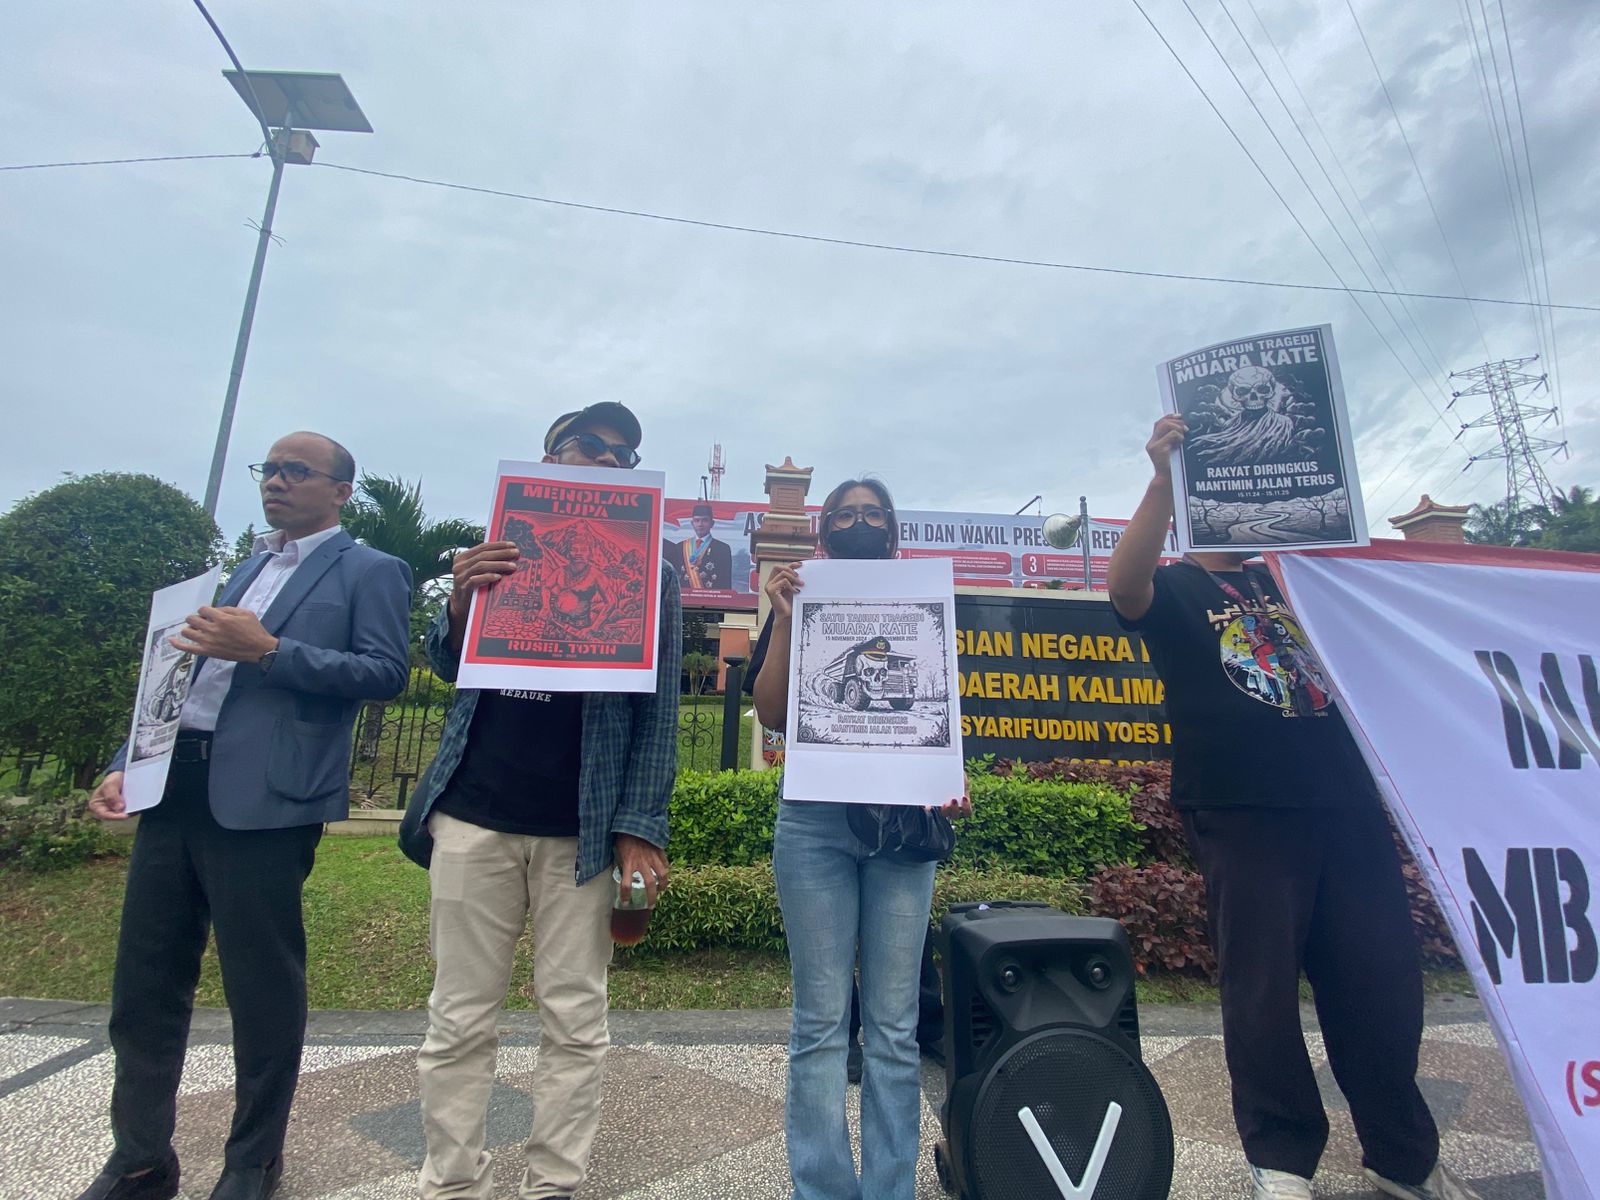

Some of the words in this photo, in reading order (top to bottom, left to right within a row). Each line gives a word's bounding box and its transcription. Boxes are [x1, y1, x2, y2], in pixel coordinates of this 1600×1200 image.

[1174, 354, 1206, 370] SATU
[1210, 342, 1254, 358] TAHUN
[1257, 334, 1315, 350] TRAGEDI
[1175, 355, 1252, 384] MUARA
[1260, 346, 1318, 367] KATE
[1206, 465, 1250, 478] RAKYAT
[1253, 461, 1318, 476] DIRINGKUS
[1195, 479, 1253, 492] MANTIMIN
[1256, 477, 1292, 489] JALAN
[1295, 473, 1335, 487] TERUS
[523, 484, 639, 507] MENOLAK
[552, 501, 608, 518] LUPA
[900, 522, 918, 541] EN
[924, 523, 955, 543] DAN
[960, 525, 1008, 545] WAKIL
[1092, 530, 1122, 549] REP
[1029, 556, 1037, 573] 3
[820, 612, 845, 622] SATU
[847, 613, 879, 623] TAHUN
[822, 623, 876, 635] MUARA
[880, 623, 918, 635] KATE
[507, 640, 563, 653] RUSEL
[568, 643, 616, 655] TOTIN
[956, 629, 1013, 657] SIAN
[1021, 632, 1135, 662] NEGARA
[500, 688, 552, 702] MERAUKE
[1067, 675, 1165, 705] KALIM
[960, 715, 1099, 742] SYARIFUDDIN
[1104, 721, 1159, 745] YOES
[1428, 846, 1599, 984] MB
